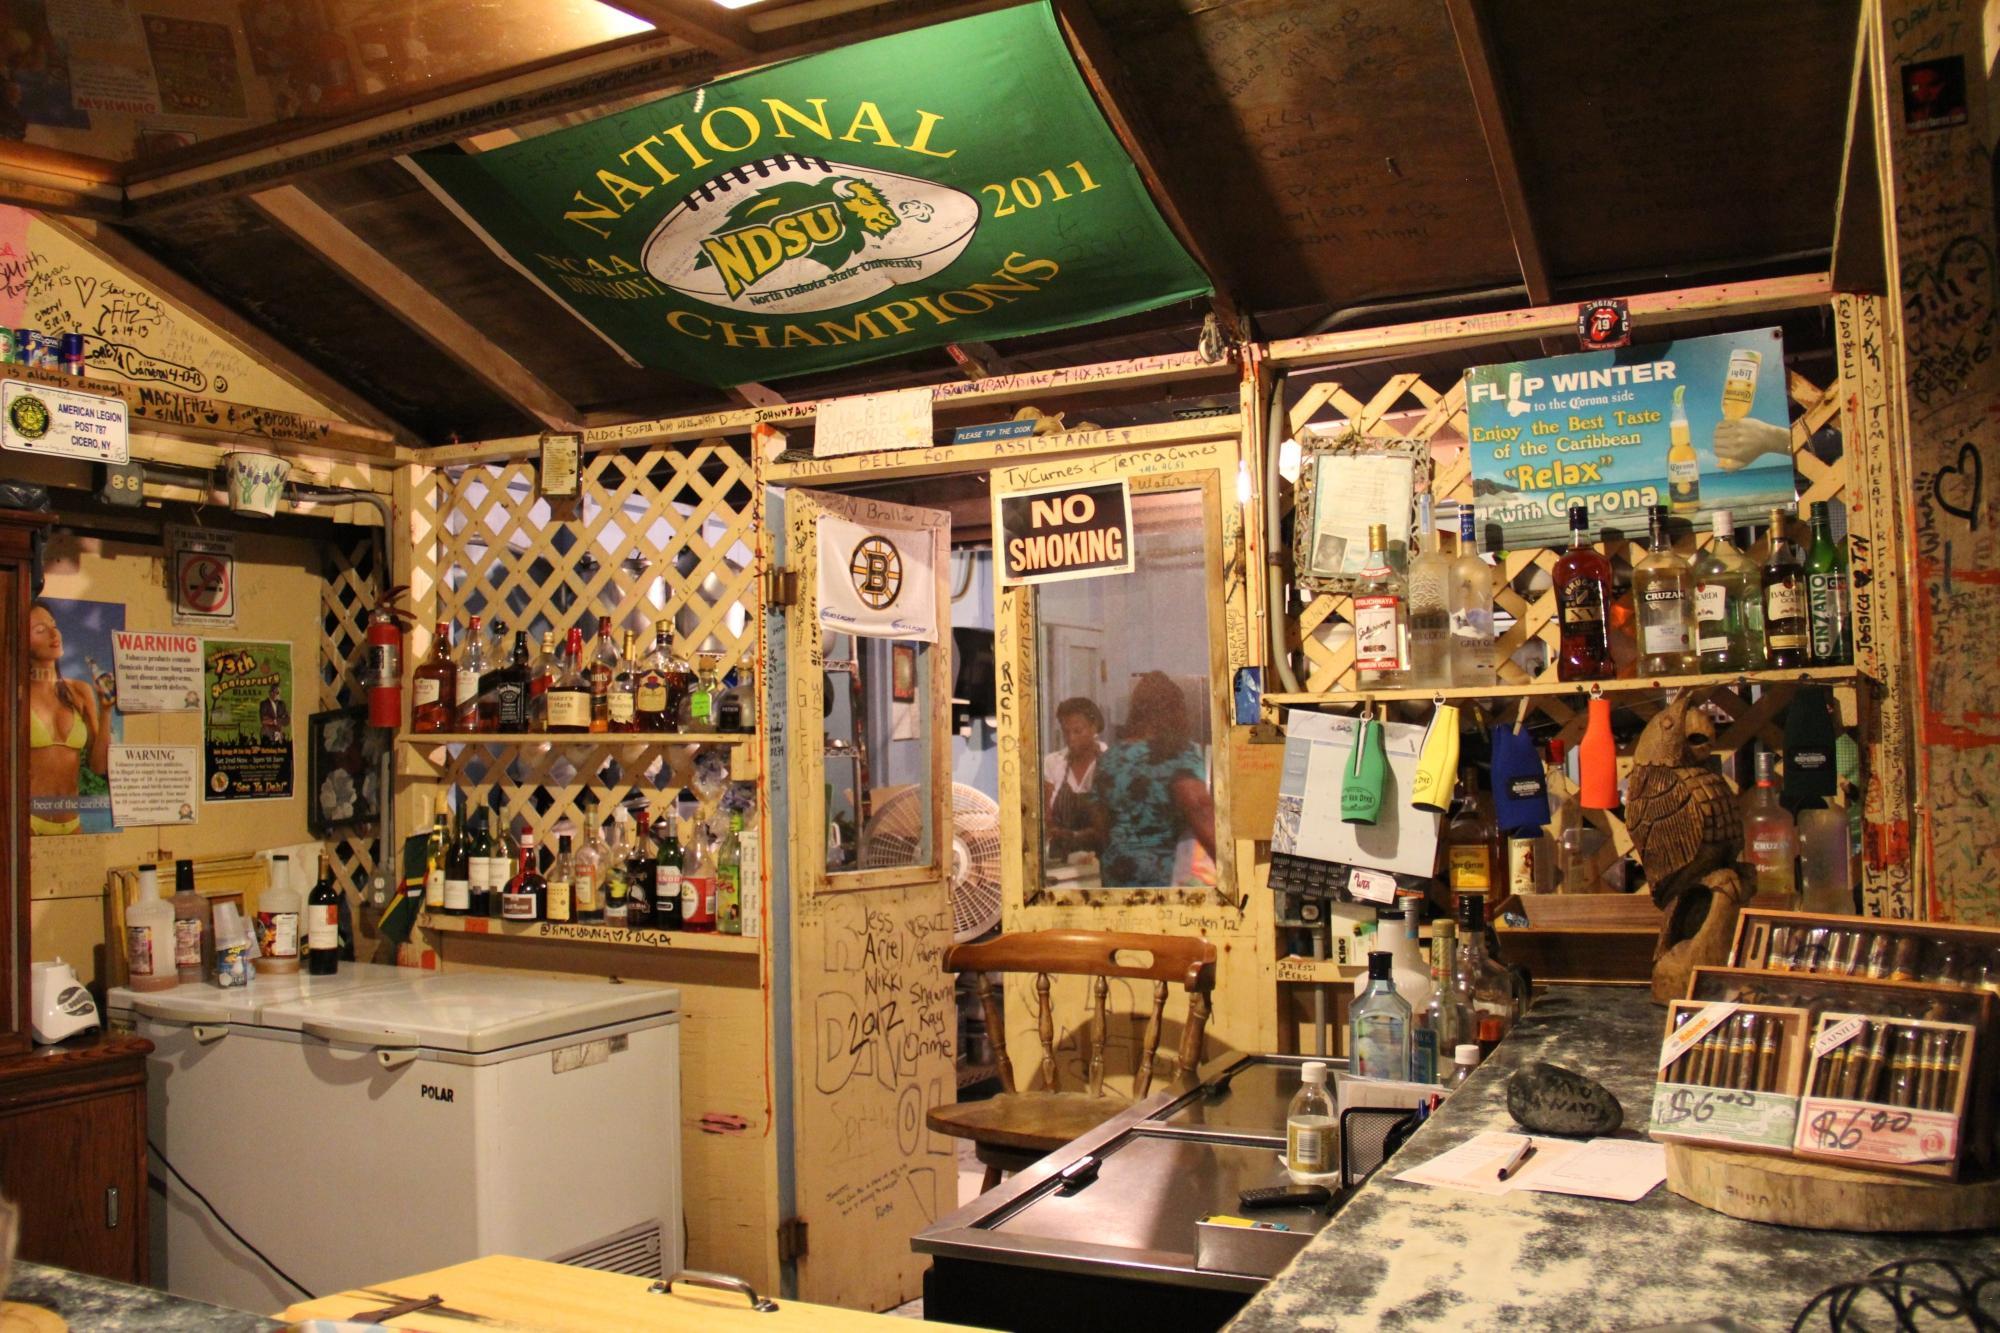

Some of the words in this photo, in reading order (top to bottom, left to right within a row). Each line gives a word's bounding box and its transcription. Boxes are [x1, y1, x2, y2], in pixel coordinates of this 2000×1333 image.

[563, 98, 958, 240] NATIONAL
[981, 160, 1102, 218] 2011
[543, 254, 640, 277] NCAA
[702, 205, 842, 300] NDSU
[558, 273, 654, 299] DIVISION
[750, 286, 783, 306] North
[785, 277, 827, 299] Dakota
[827, 265, 859, 285] State
[859, 257, 923, 275] University
[665, 252, 1060, 350] CHAMPIONS
[1597, 319, 1610, 331] 19
[1551, 360, 1676, 394] WINTER
[58, 403, 95, 418] AMERICAN
[96, 409, 122, 424] LEGION
[1534, 401, 1548, 412] to
[1550, 397, 1567, 410] the
[1569, 395, 1609, 410] Corona
[1611, 390, 1635, 404] side
[75, 421, 93, 434] POST
[95, 422, 107, 435] 787
[754, 407, 794, 424] JOHNNY
[1472, 425, 1522, 444] Enjoy
[1531, 419, 1560, 436] the
[1568, 413, 1604, 432] Best
[1613, 408, 1662, 427] Taste
[71, 435, 100, 451] CICERO,
[101, 439, 111, 450] NY
[957, 430, 984, 442] PLEASE
[985, 429, 996, 439] TIP
[999, 427, 1013, 438] THE
[1015, 425, 1033, 436] COOK
[1493, 444, 1512, 460] of
[1519, 440, 1548, 457] the
[1556, 431, 1642, 453] Caribbean
[790, 460, 833, 476] RING
[859, 452, 906, 469] BELL
[994, 429, 1117, 455] ASSISTANCE
[1669, 461, 1696, 473] Corona
[1031, 494, 1096, 529] NO
[1500, 504, 1543, 524] with
[1547, 484, 1660, 518] Corona
[1008, 526, 1124, 572] SMOKING
[1645, 590, 1685, 602] CRUZAN
[1811, 574, 1827, 657] CINZANO
[117, 633, 197, 654] WARNING
[1460, 640, 1481, 648] GREY
[214, 651, 257, 677] 13th
[211, 672, 281, 699] Anniversary
[125, 749, 176, 760] WARNING
[33, 799, 54, 810] beer
[54, 799, 64, 809] of
[64, 798, 78, 809] the
[857, 906, 895, 936] Jess
[862, 932, 904, 970] Ariel
[848, 1001, 905, 1056] 2012
[917, 1005, 946, 1036] Ray
[420, 1084, 455, 1103] POLAR
